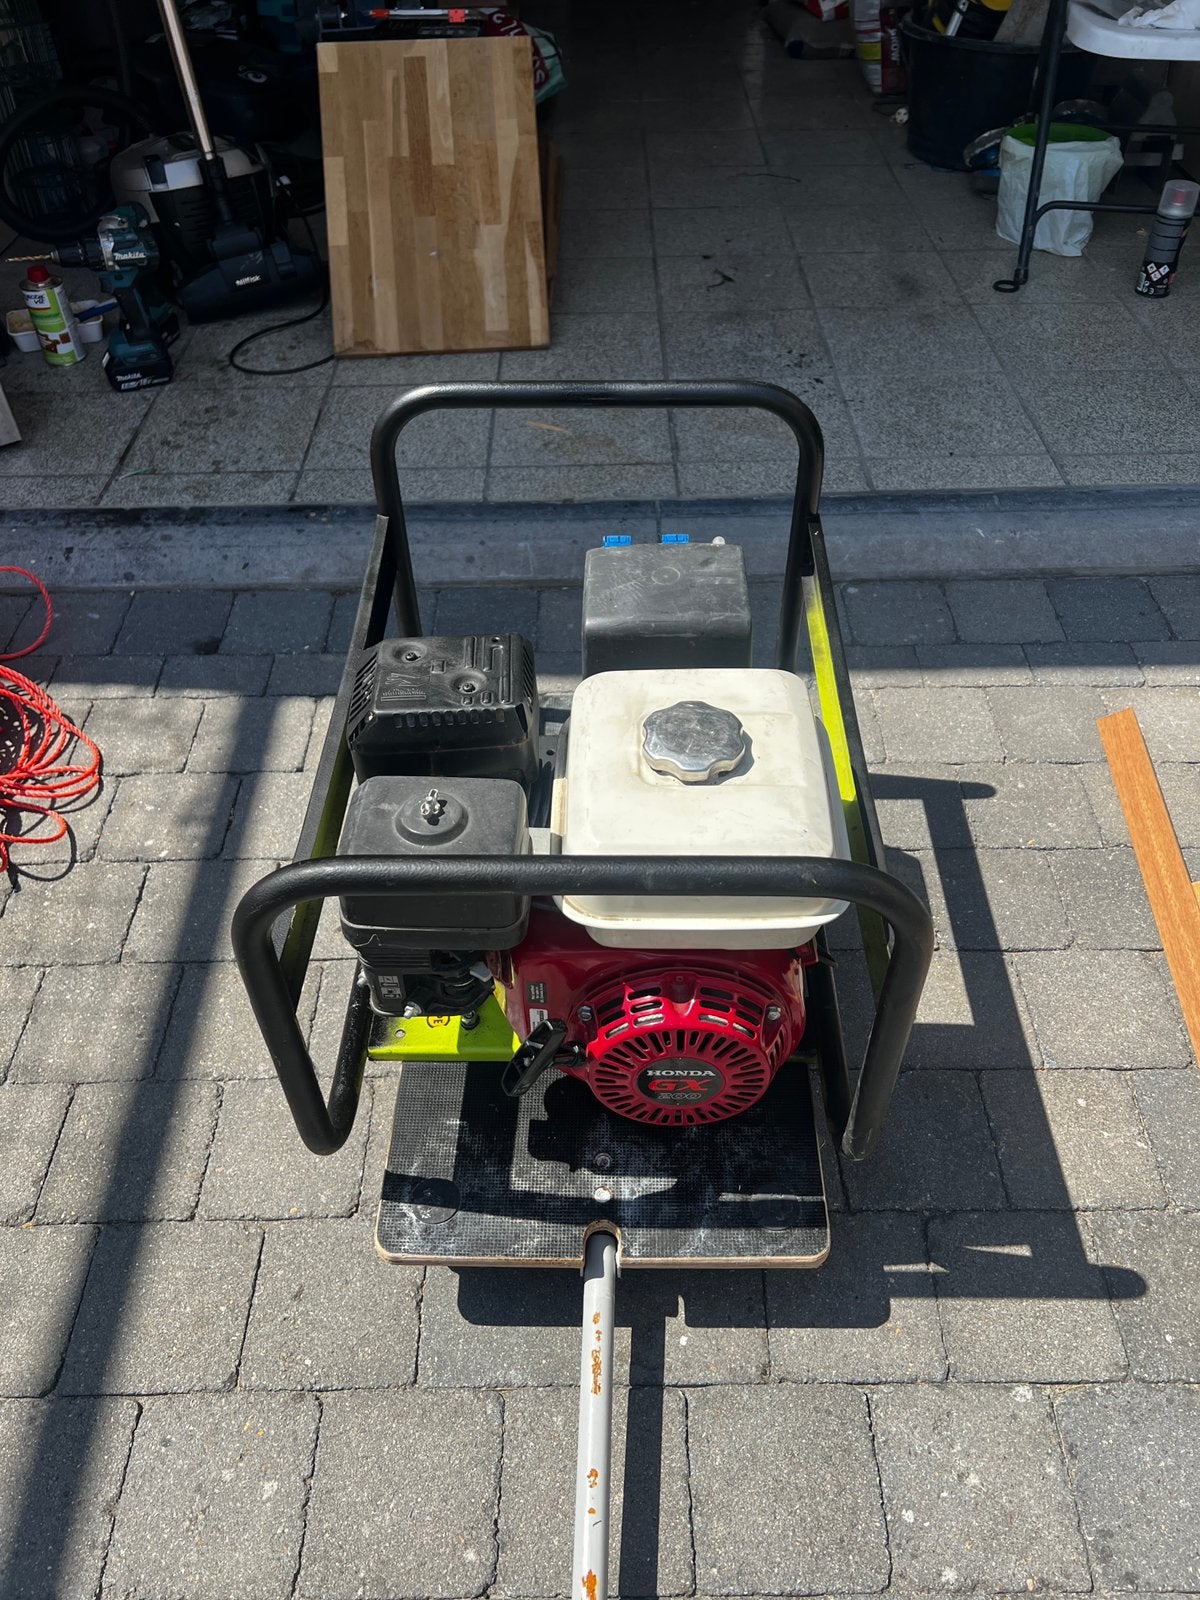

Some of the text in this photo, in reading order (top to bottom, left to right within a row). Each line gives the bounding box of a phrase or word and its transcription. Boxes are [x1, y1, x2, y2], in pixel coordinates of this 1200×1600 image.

[113, 251, 146, 260] Makita
[646, 1069, 717, 1077] HONDA
[647, 1079, 713, 1091] GX
[658, 1092, 702, 1100] 200
